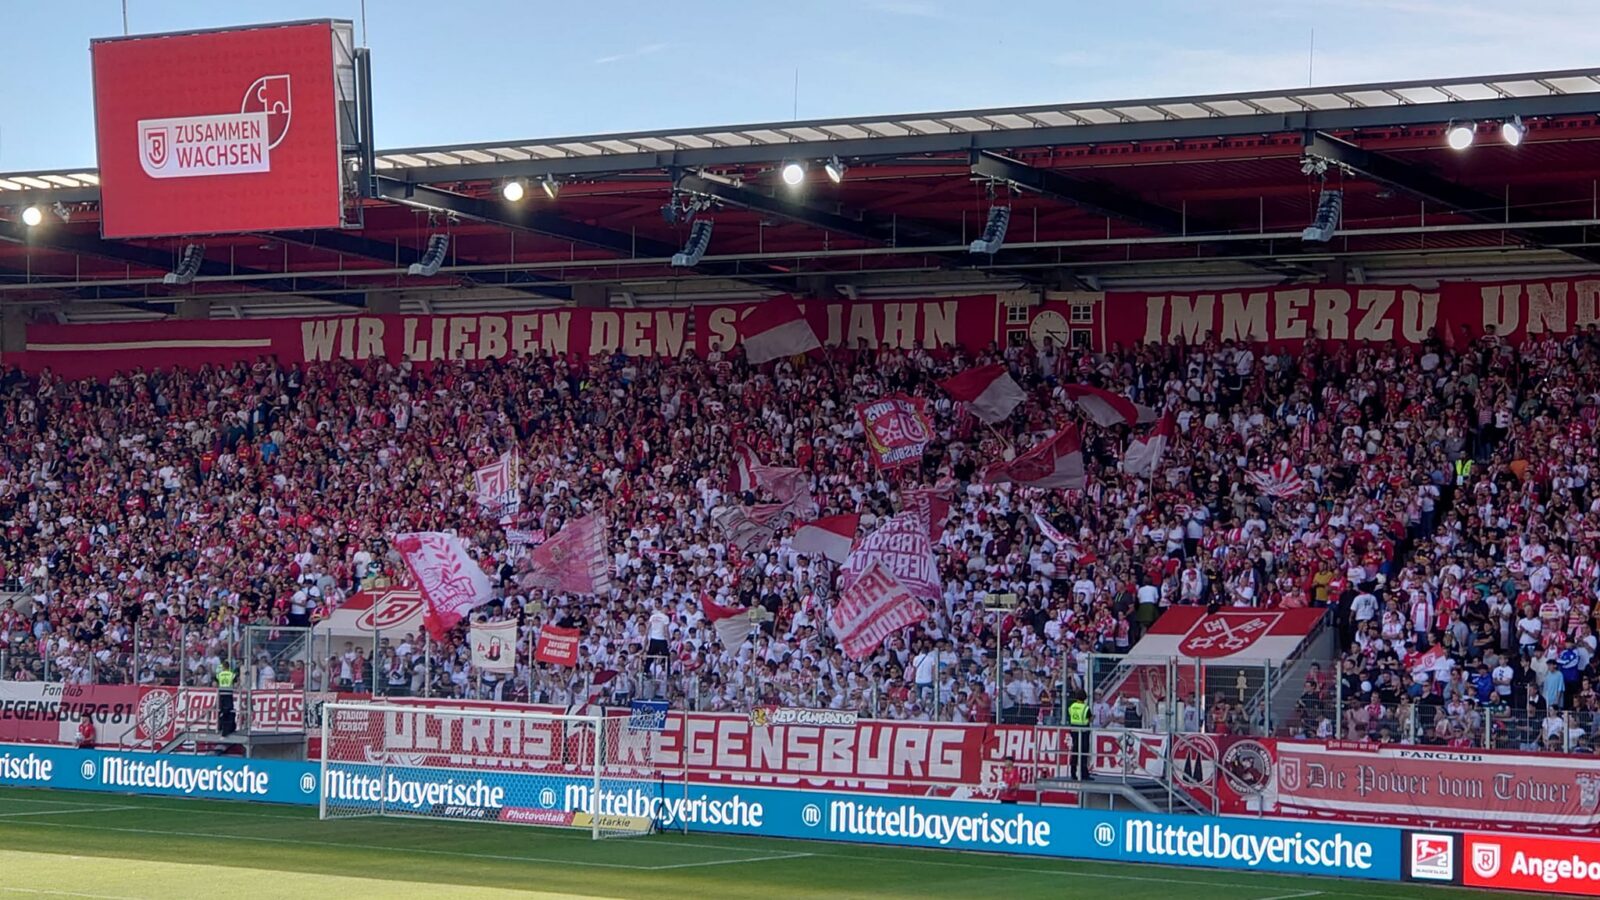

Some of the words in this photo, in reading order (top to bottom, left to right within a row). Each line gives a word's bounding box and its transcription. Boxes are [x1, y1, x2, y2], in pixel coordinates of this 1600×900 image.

[175, 120, 260, 144] ZUSAMMEN
[176, 143, 262, 168] WACHSEN
[823, 300, 958, 350] JAHN
[1143, 288, 1441, 346] IMMERZU
[301, 317, 385, 362] WIR
[403, 312, 572, 362] LIEBEN
[589, 311, 686, 358] DEN
[42, 683, 83, 697] Fanclub
[111, 703, 134, 724] 81
[384, 704, 551, 757] ULTRAS
[616, 716, 966, 779] REGENSBURG
[991, 729, 1058, 762] JAHN
[1400, 750, 1483, 762] FANCLUB
[102, 756, 269, 794] Mittelbayerische
[1306, 762, 1346, 790] Die
[1354, 763, 1430, 797] Power
[1437, 771, 1484, 800] vom
[1493, 772, 1571, 804] Tower
[505, 809, 566, 823] Photovoltaik
[829, 800, 1051, 847] Mittelbayerische
[1126, 819, 1372, 870] Mittelbayerische
